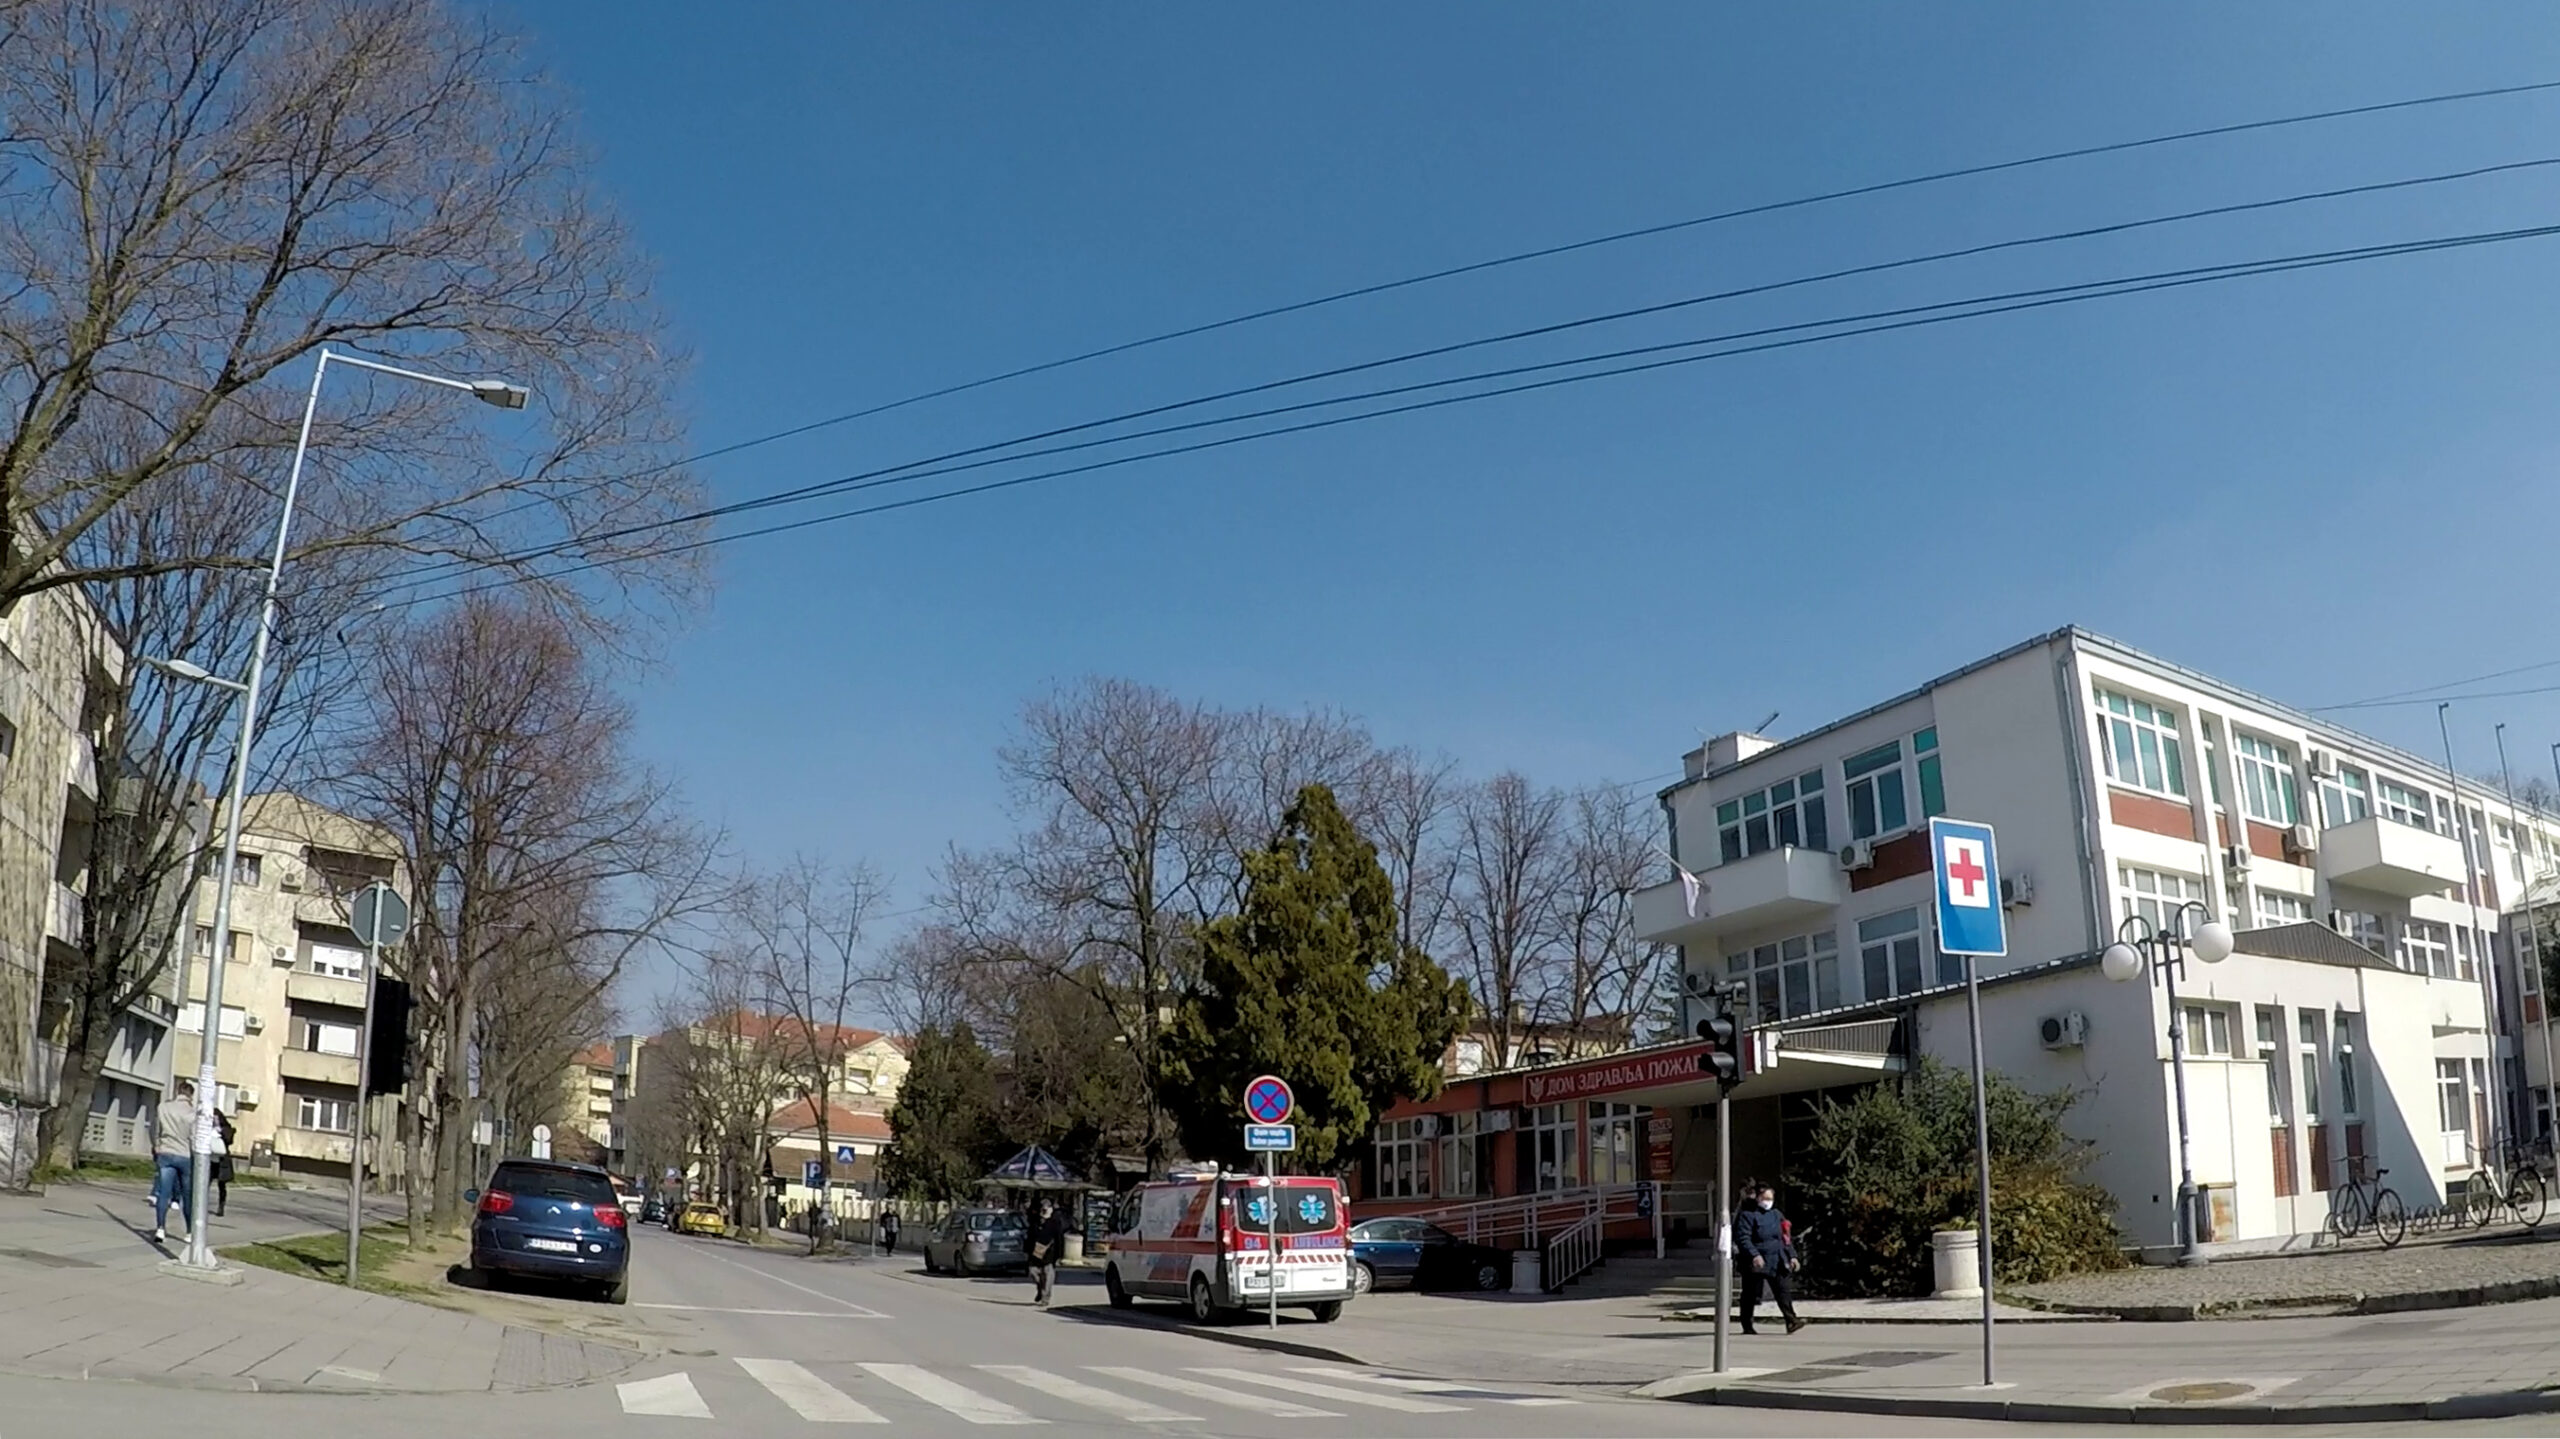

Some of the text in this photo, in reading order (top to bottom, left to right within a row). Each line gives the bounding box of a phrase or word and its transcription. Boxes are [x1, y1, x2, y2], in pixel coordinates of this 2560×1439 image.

[1546, 1077, 1575, 1096] ДОМ
[1578, 1064, 1644, 1092] ЗДРАВЉА
[1244, 1237, 1261, 1249] 94
